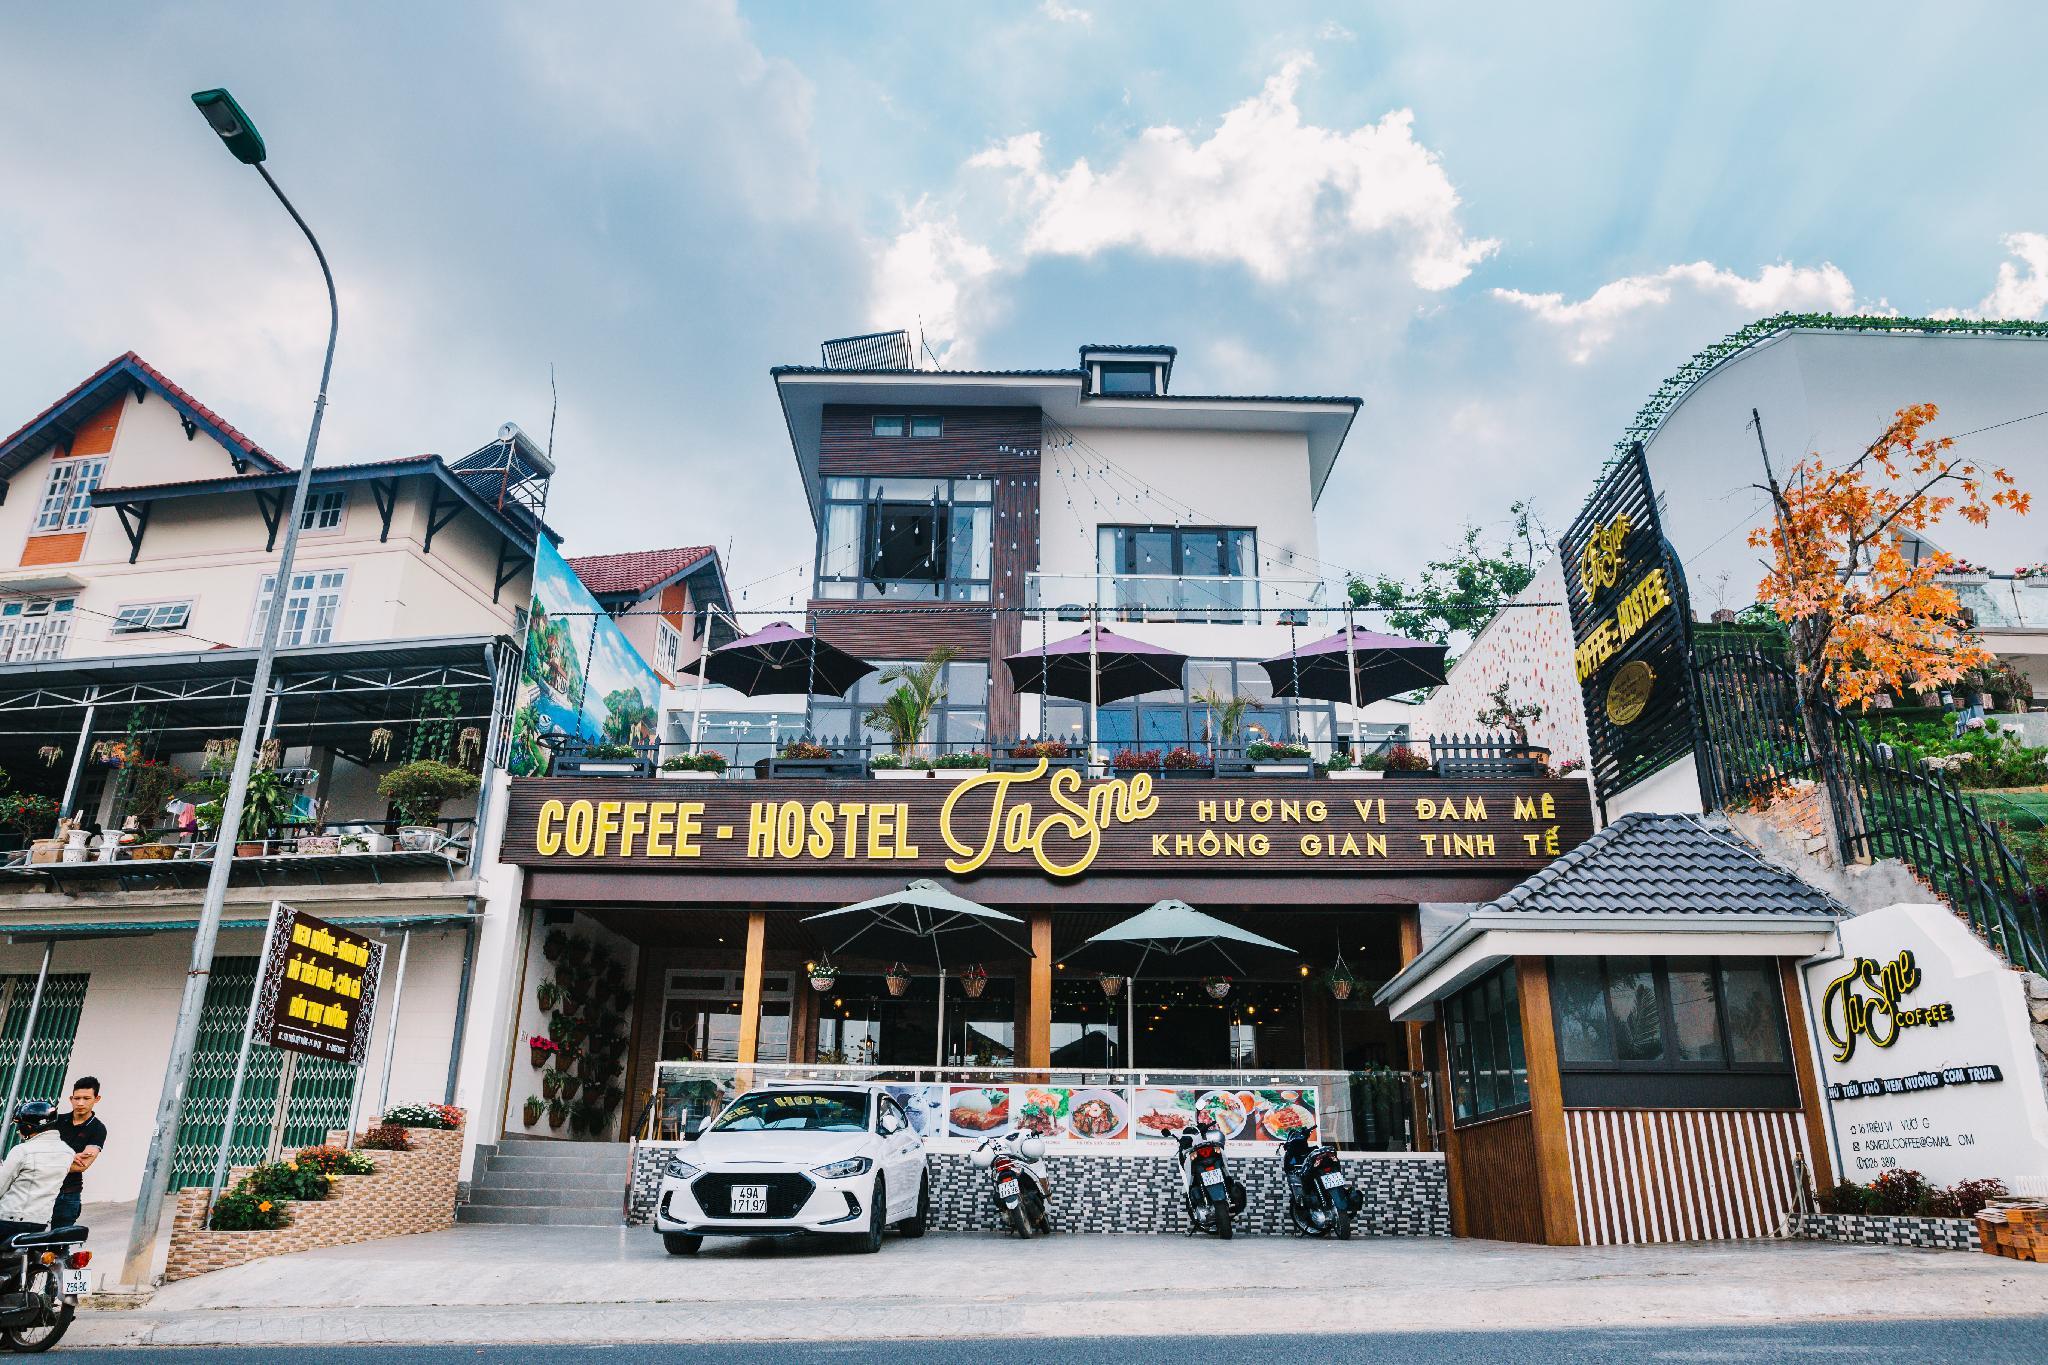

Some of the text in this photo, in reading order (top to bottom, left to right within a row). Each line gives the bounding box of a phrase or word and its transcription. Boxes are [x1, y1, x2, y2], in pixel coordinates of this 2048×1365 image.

[1574, 618, 1615, 684] COFFEE
[939, 757, 1160, 877] TaSme
[1198, 798, 1328, 823] HƯƠNG
[1513, 792, 1556, 821] MÊ
[536, 799, 920, 859] COFFEE - HOSTEL
[1152, 825, 1561, 858] KHÔNG GIAN TINH TẾ
[1896, 1003, 1954, 1028] COFFEE
[1884, 1079, 1903, 1093] NEM
[732, 1199, 766, 1213] 171.97
[739, 1186, 759, 1199] 49A
